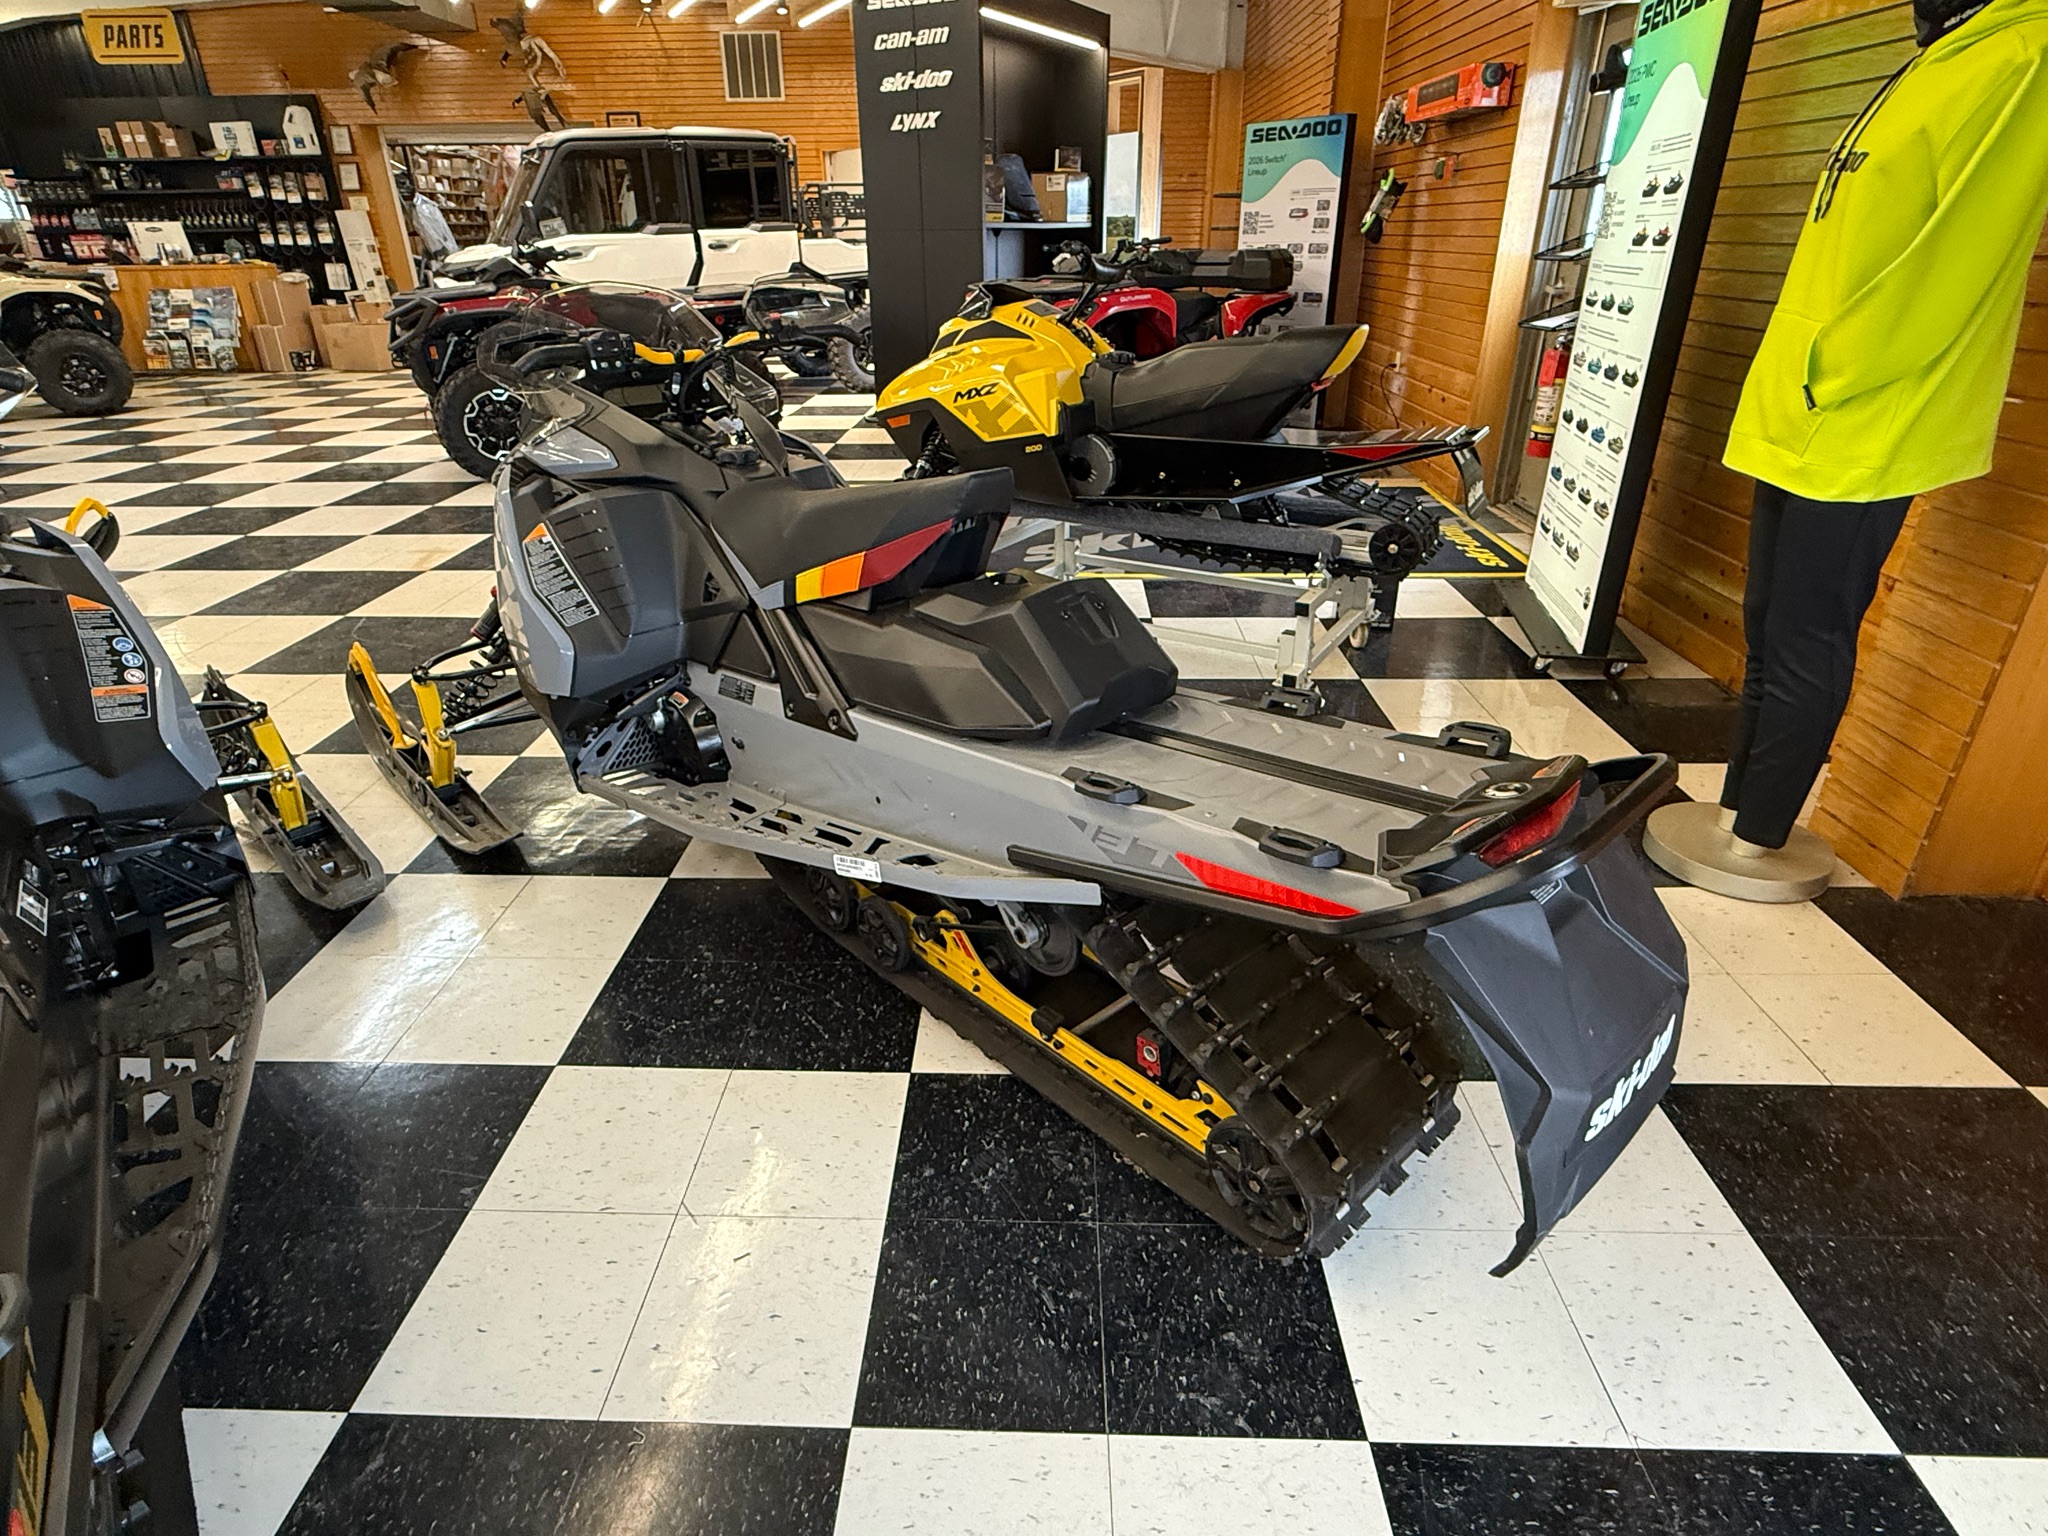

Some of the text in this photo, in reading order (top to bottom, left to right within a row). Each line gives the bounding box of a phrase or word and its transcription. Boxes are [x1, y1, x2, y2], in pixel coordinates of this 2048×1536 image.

[103, 24, 164, 48] PARTS
[874, 26, 950, 51] can-am
[879, 68, 953, 93] ski-doo
[890, 111, 941, 132] LYNX
[953, 382, 1000, 404] MXZ
